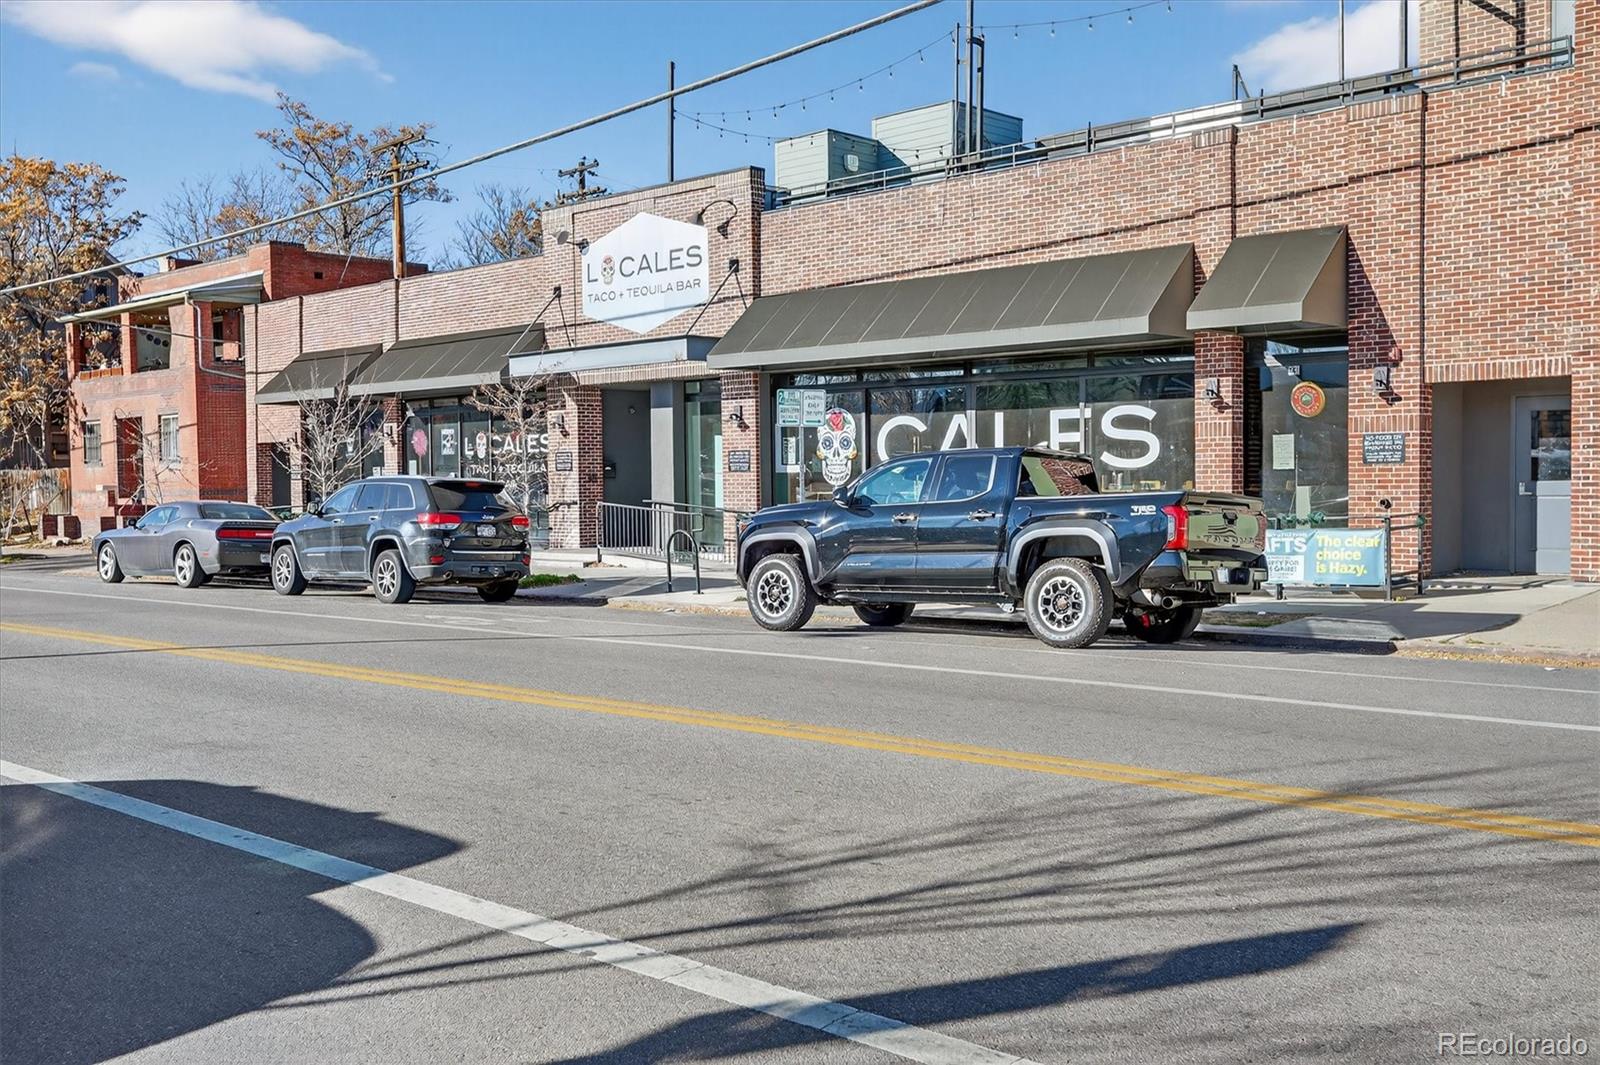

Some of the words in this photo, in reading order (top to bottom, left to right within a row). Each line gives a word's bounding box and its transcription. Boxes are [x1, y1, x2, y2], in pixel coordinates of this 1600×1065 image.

[588, 290, 616, 303] TACO
[627, 283, 673, 298] TEQUILA
[676, 279, 701, 291] BAR
[1316, 535, 1341, 547] The
[1344, 535, 1380, 548] clear
[1316, 548, 1361, 560] choice
[1316, 562, 1326, 573] is
[1329, 562, 1367, 577] Hazy.
